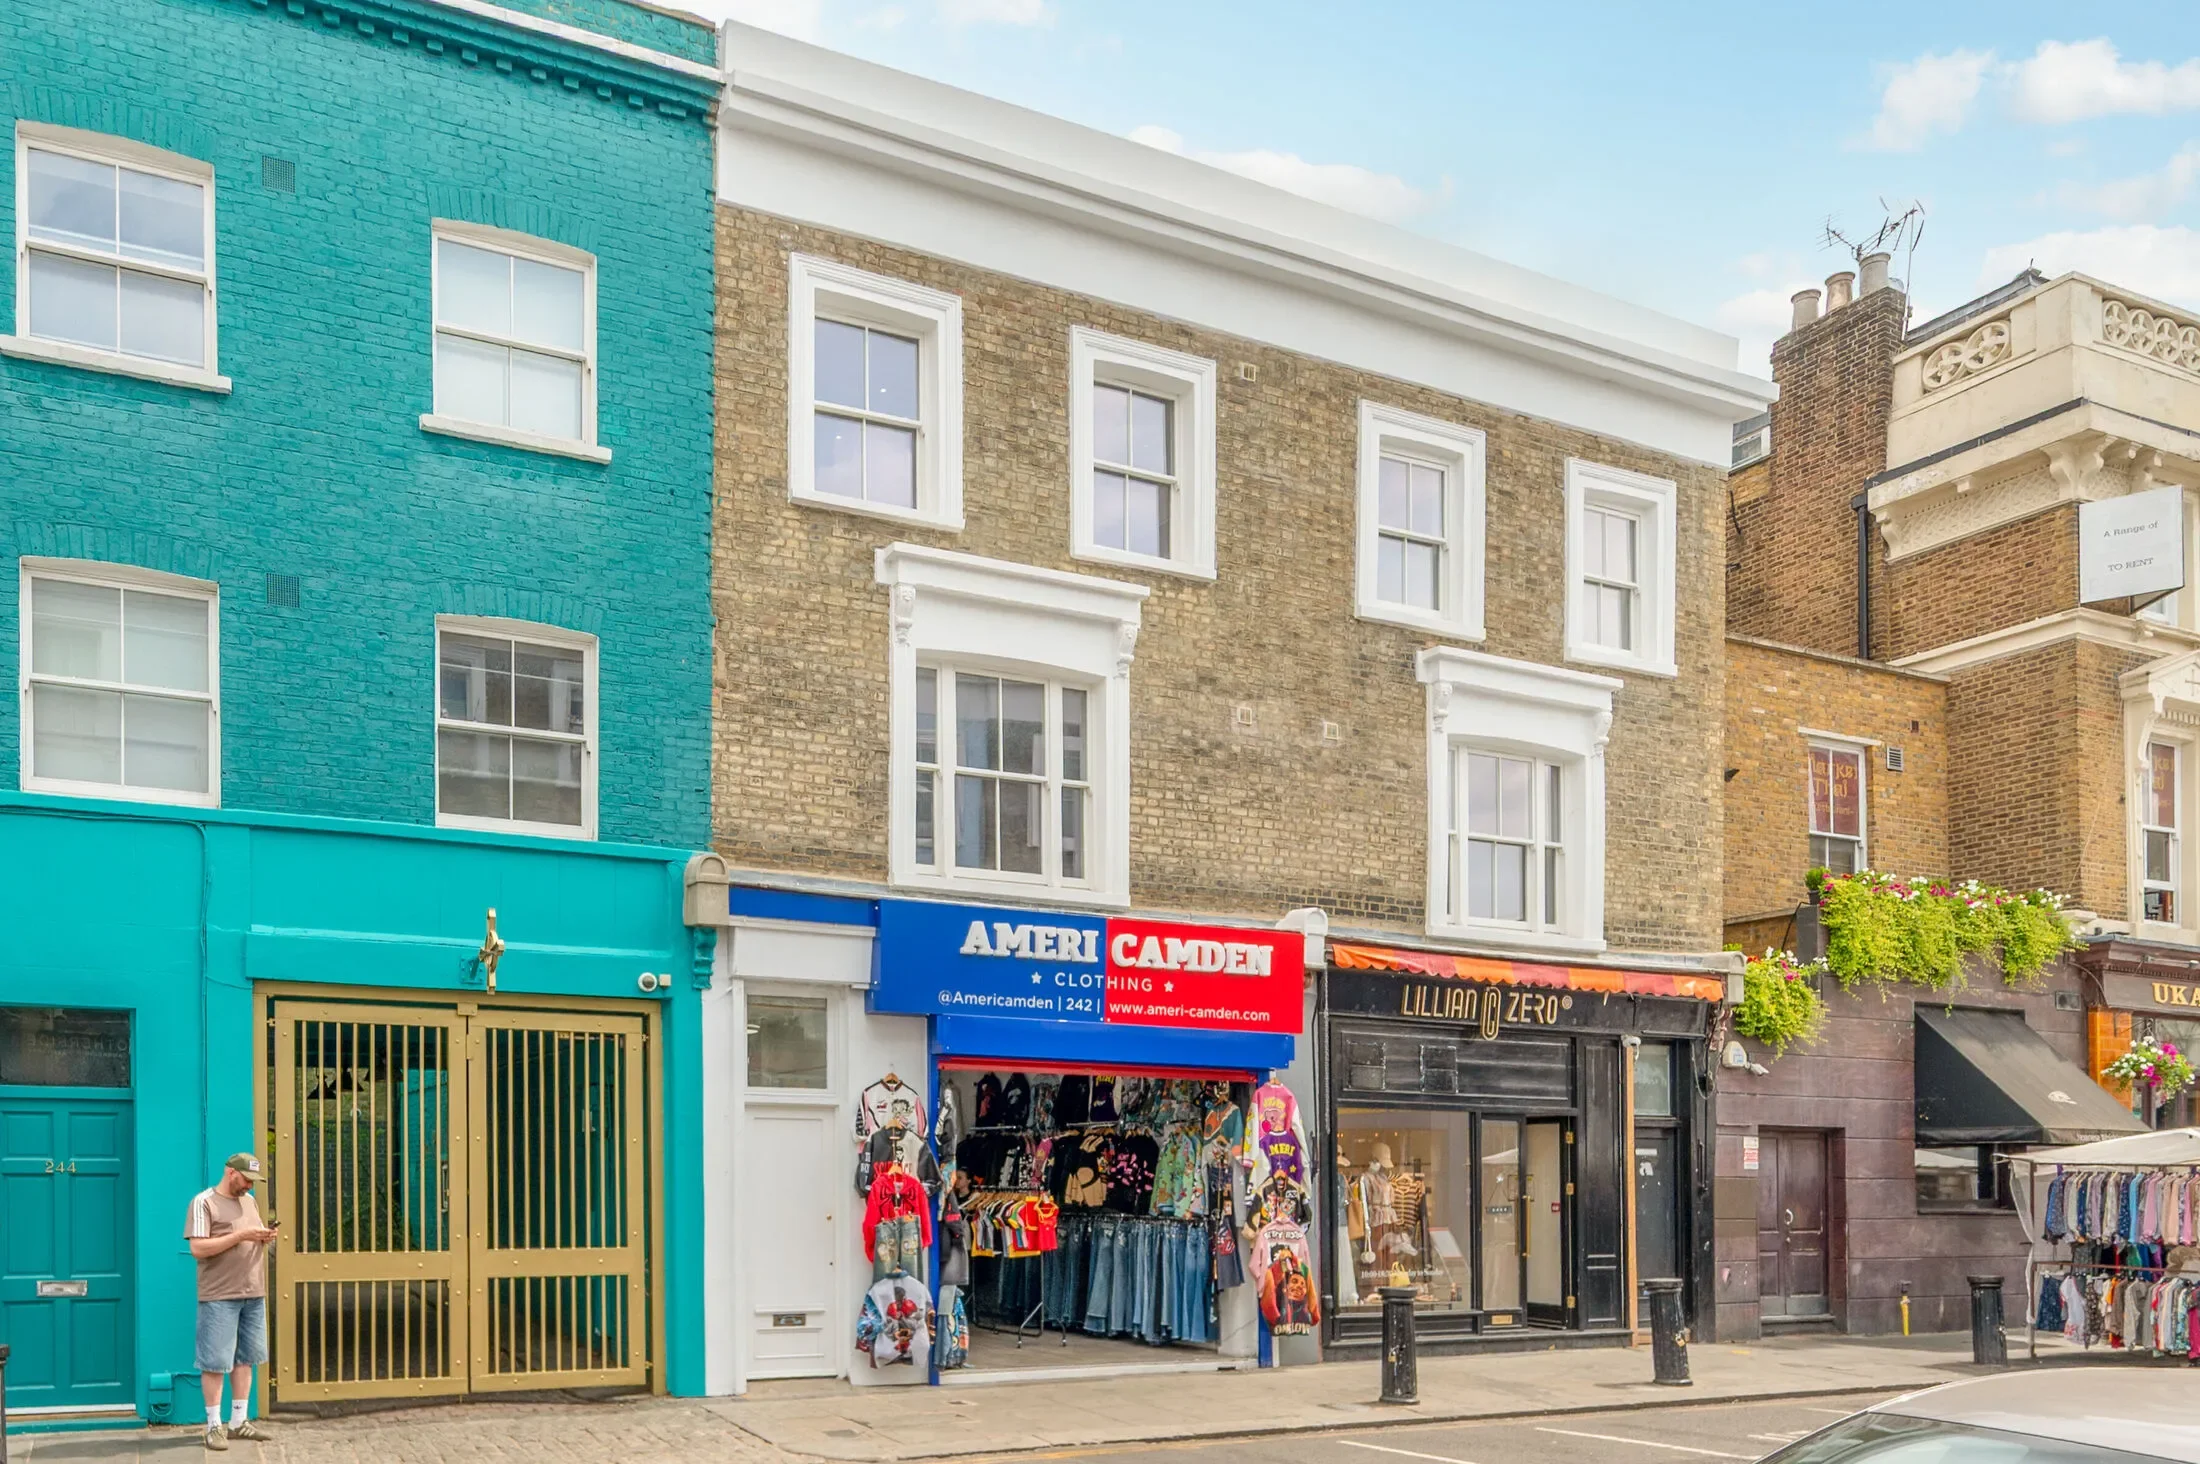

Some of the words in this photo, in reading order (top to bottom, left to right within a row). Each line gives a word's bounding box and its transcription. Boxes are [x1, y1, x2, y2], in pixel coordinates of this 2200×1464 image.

[2103, 530, 2111, 538] A
[2113, 525, 2146, 536] Range
[2148, 520, 2159, 529] of
[2107, 563, 2123, 572] TO
[2125, 557, 2154, 569] RENT
[959, 920, 1099, 963] AMERI
[1111, 933, 1274, 977] CAMDEN
[1054, 972, 1153, 993] CLOTHING
[938, 989, 1053, 1010] @Americamden
[1066, 997, 1092, 1012] 242
[1109, 1002, 1271, 1022] www.ameri-camden.com
[1401, 984, 1477, 1020] LILLIAN
[44, 1160, 77, 1174] 244
